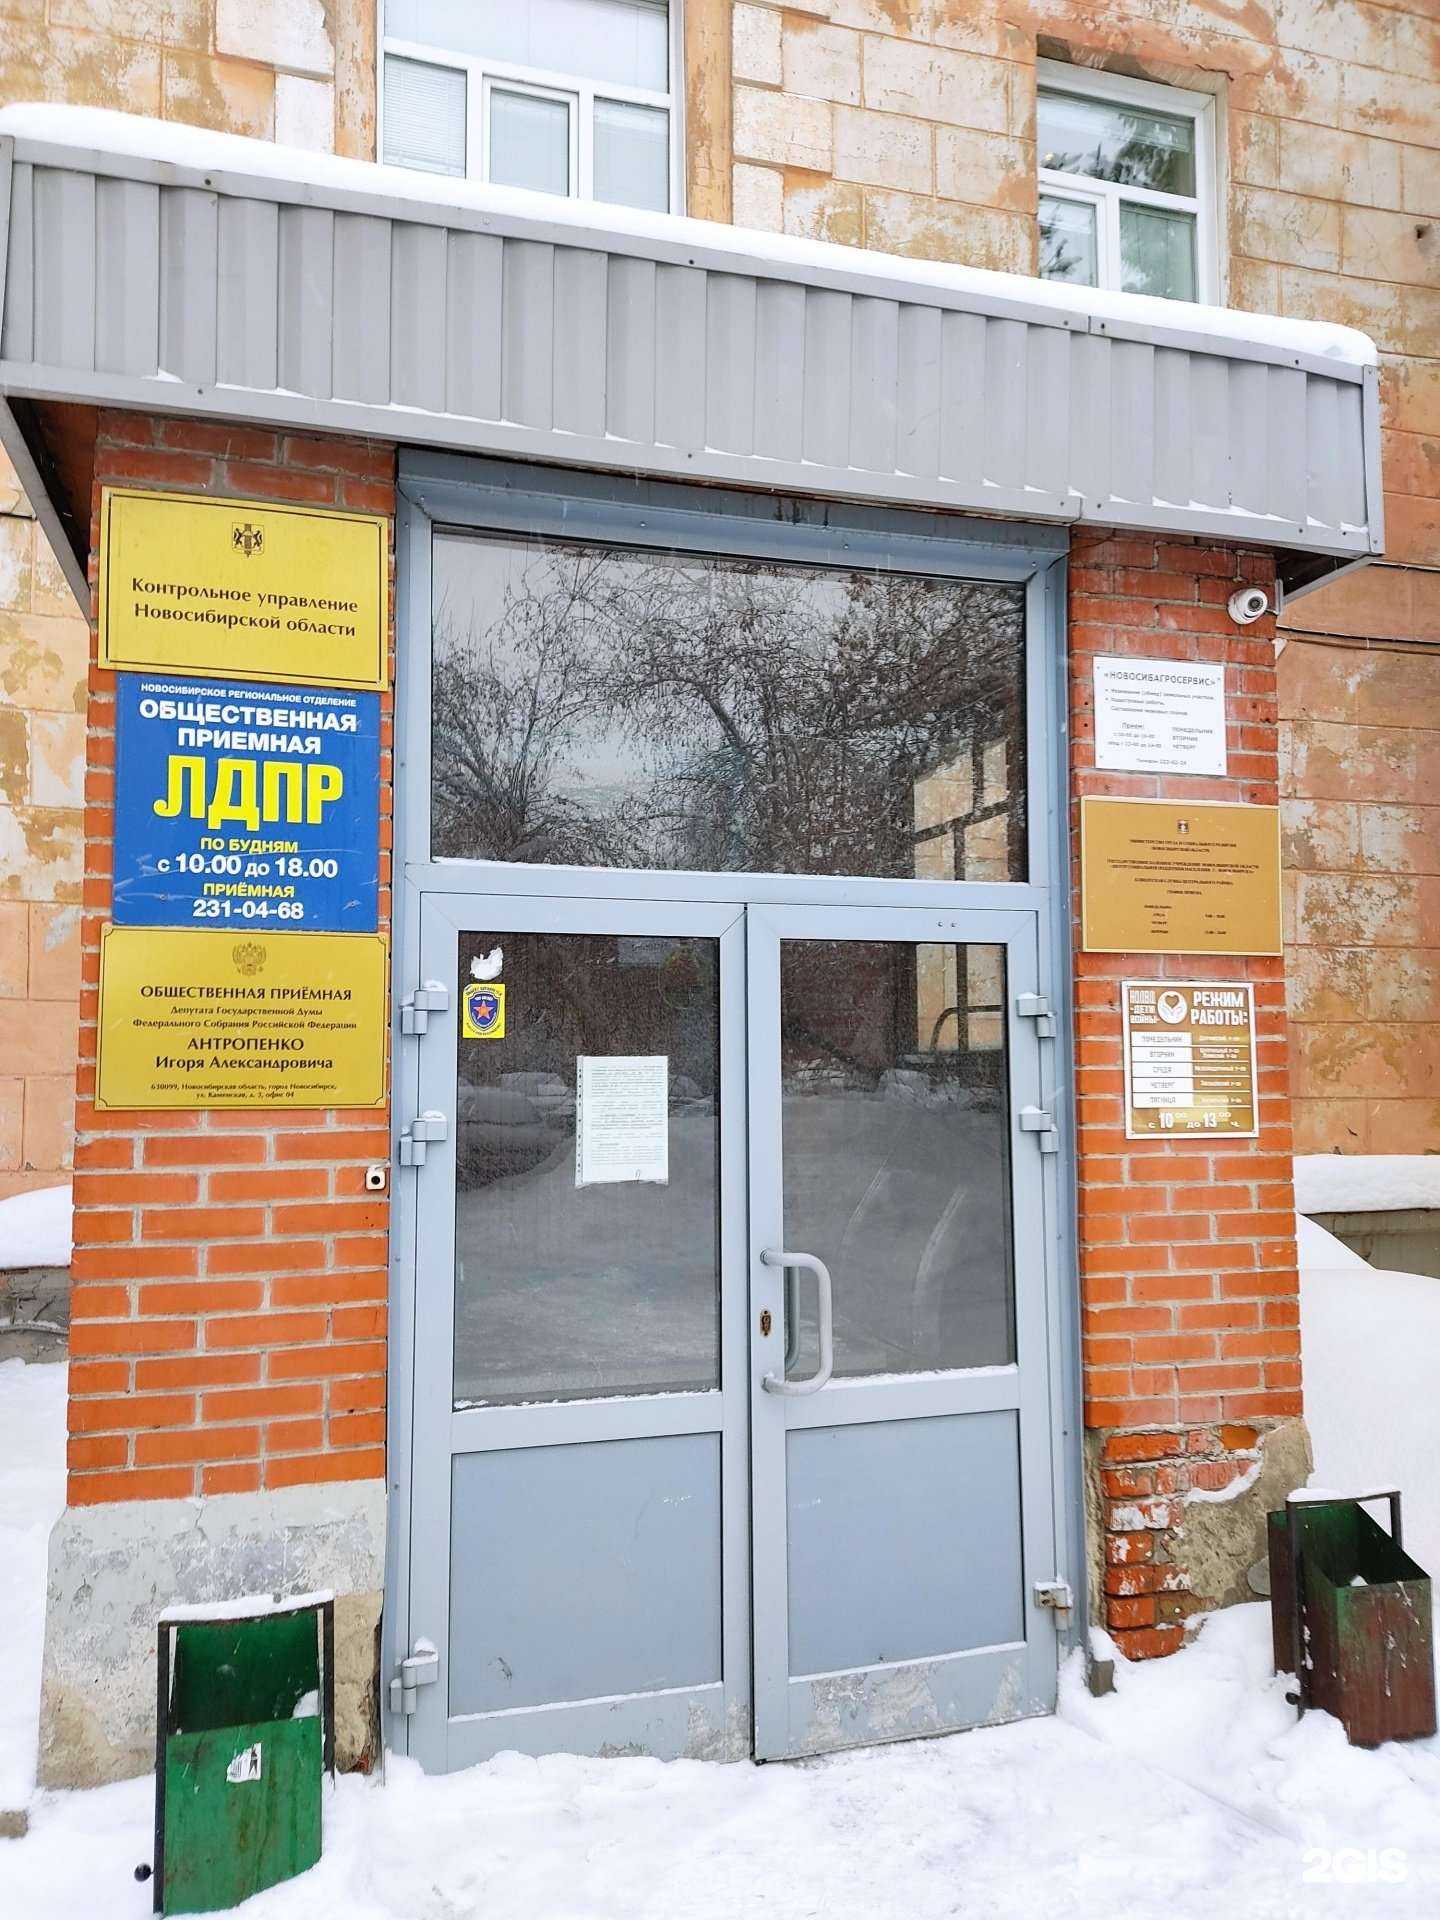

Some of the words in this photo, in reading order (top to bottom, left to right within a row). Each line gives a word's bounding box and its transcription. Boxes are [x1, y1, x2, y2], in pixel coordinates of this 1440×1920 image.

[132, 577, 251, 602] Контрольное
[257, 592, 358, 613] управление
[134, 603, 280, 630] Новосибирской
[286, 619, 356, 637] области
[141, 683, 227, 698] НОВОСИБИРСКОЕ
[228, 690, 302, 704] РЕГИОНАЛЬНОЕ
[303, 694, 357, 708] ОТДЕЛЕНИЕ
[139, 699, 357, 732] ОБЩЕСТВЕННАЯ
[178, 728, 321, 755] ПРИЕМНАЯ
[153, 754, 344, 831] ЛДПР
[200, 837, 225, 851] ПО
[229, 839, 299, 855] БУДНЯМ
[157, 859, 170, 872] с
[176, 853, 242, 876] 10.00
[244, 863, 270, 878] до
[274, 858, 339, 878] 18.00
[203, 882, 295, 898] ПРИЁМНАЯ
[193, 900, 304, 920] 231-04-68
[140, 985, 266, 1000] ОБЩЕСТВЕННАЯ
[270, 985, 352, 1001] ПРИЁМНАЯ
[1193, 990, 1245, 1008] РЕЖИМ
[170, 1005, 214, 1016] Депутата
[216, 1006, 295, 1018] Государственной
[296, 1007, 323, 1018] Думы
[1190, 1009, 1248, 1026] РАБОТЫ:
[132, 1018, 201, 1029] Федерального
[203, 1018, 250, 1030] Собрания
[252, 1019, 305, 1031] Российской
[307, 1020, 357, 1031] Федерации
[187, 1037, 304, 1051] АНТРОПЕНКО
[155, 1056, 205, 1070] Игоря
[211, 1056, 333, 1070] Александровича
